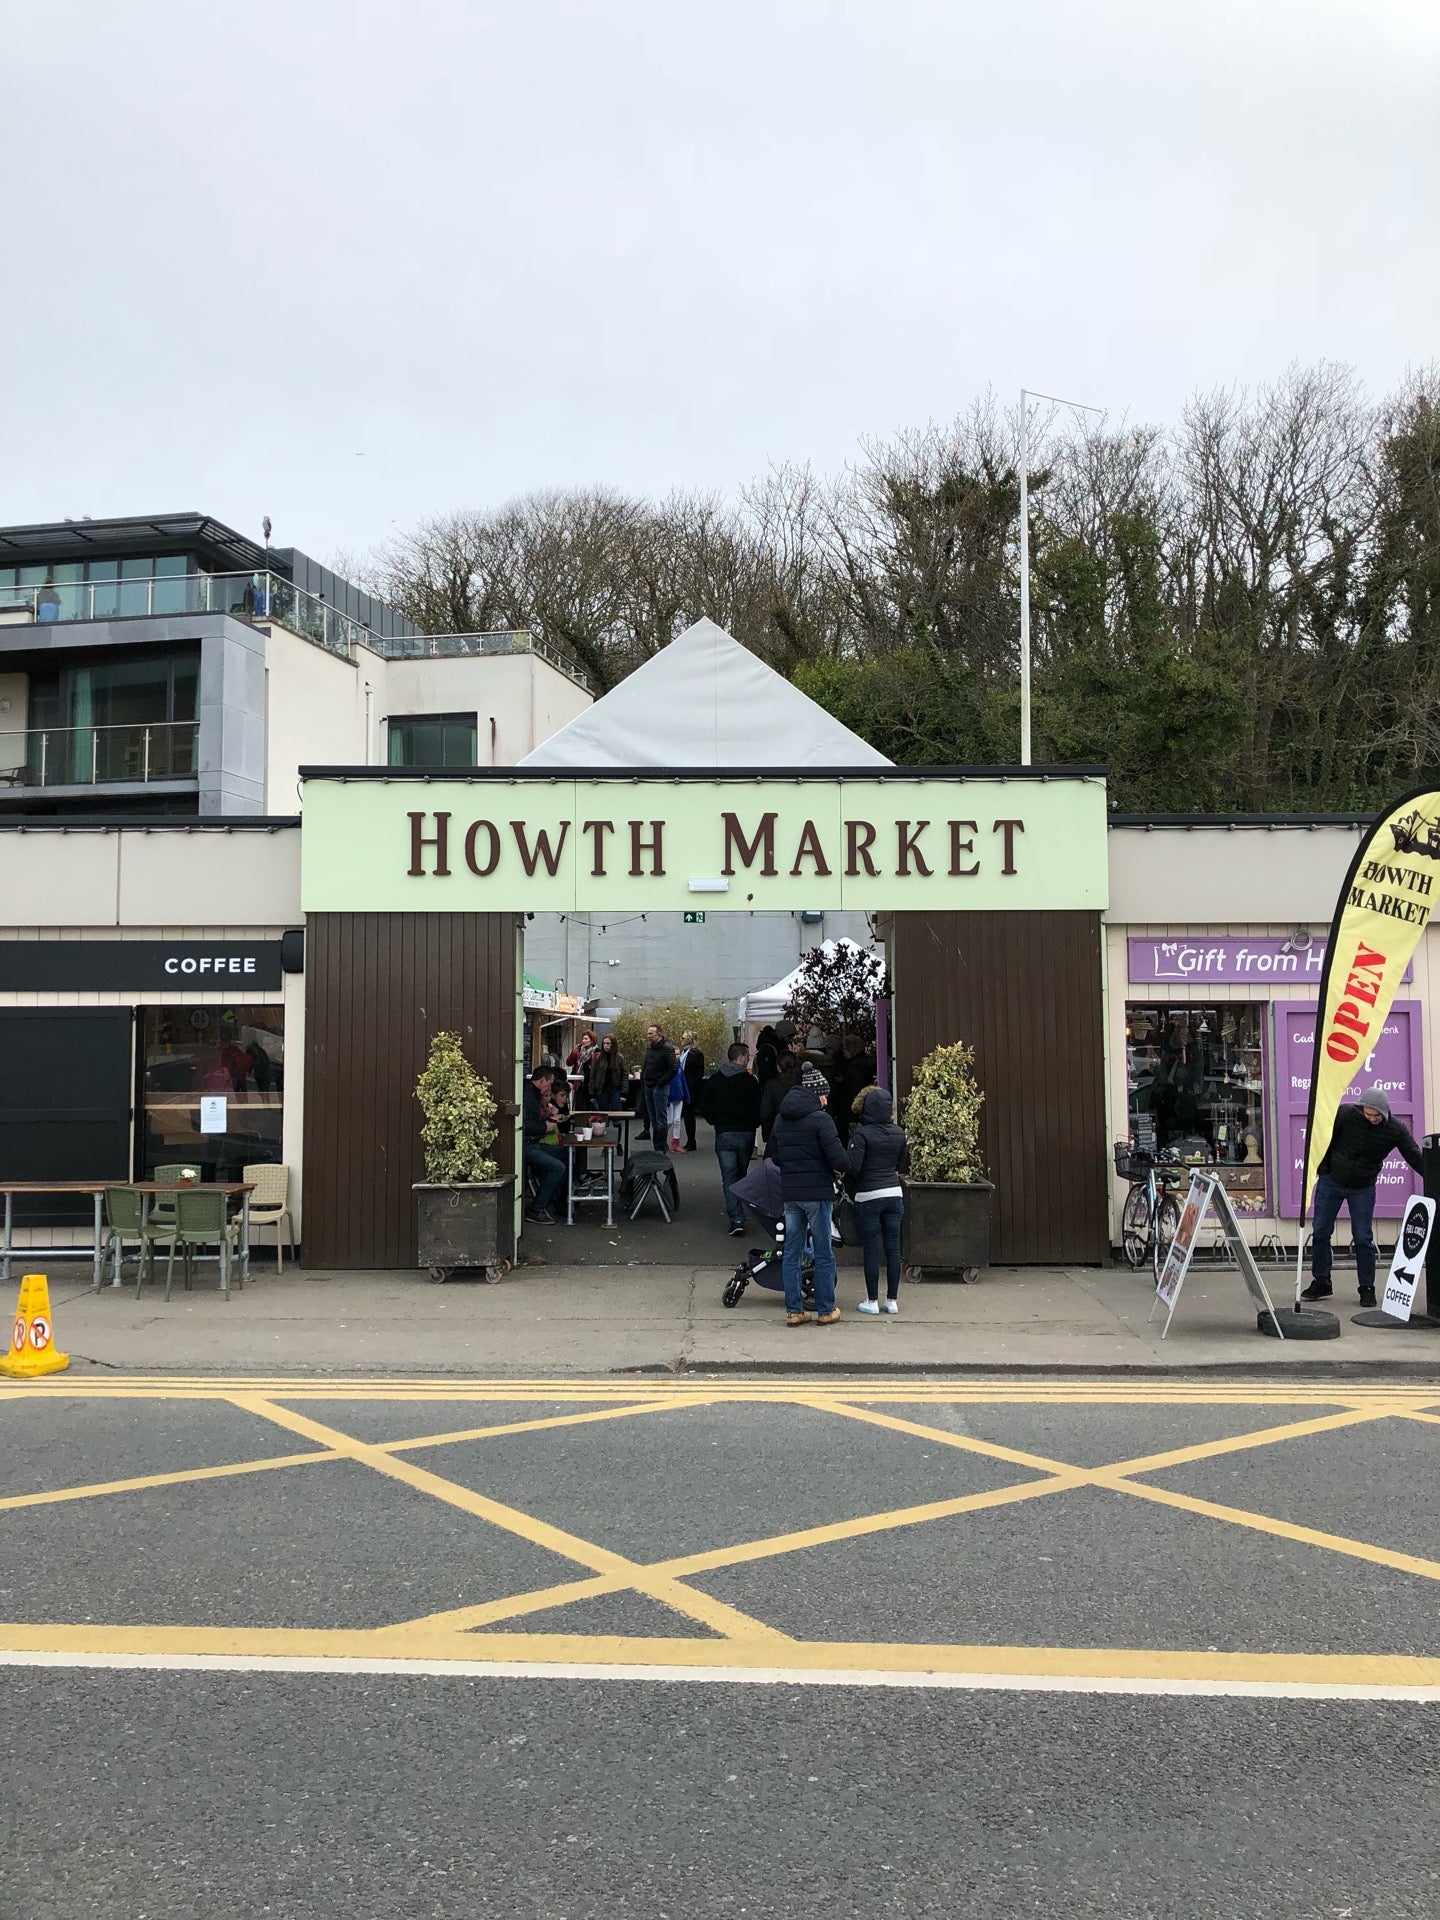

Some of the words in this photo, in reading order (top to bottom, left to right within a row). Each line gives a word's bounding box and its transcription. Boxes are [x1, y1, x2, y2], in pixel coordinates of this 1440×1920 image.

[406, 811, 666, 877] HOWTH
[721, 811, 1025, 877] MARKET
[1361, 860, 1434, 896] HOWTH
[1347, 886, 1431, 927] MARKET
[164, 957, 256, 974] COFFEE
[1177, 948, 1226, 972] Gift
[1235, 948, 1298, 972] from
[1305, 948, 1325, 972] H
[1326, 940, 1387, 1063] OPEN
[1293, 1031, 1315, 1044] Cad
[1364, 1051, 1376, 1073] t
[1291, 1076, 1311, 1090] Rega
[1343, 1086, 1362, 1096] no
[1373, 1078, 1407, 1091] Gave
[1375, 1173, 1405, 1185] shion
[1385, 1287, 1412, 1307] COFFEE
